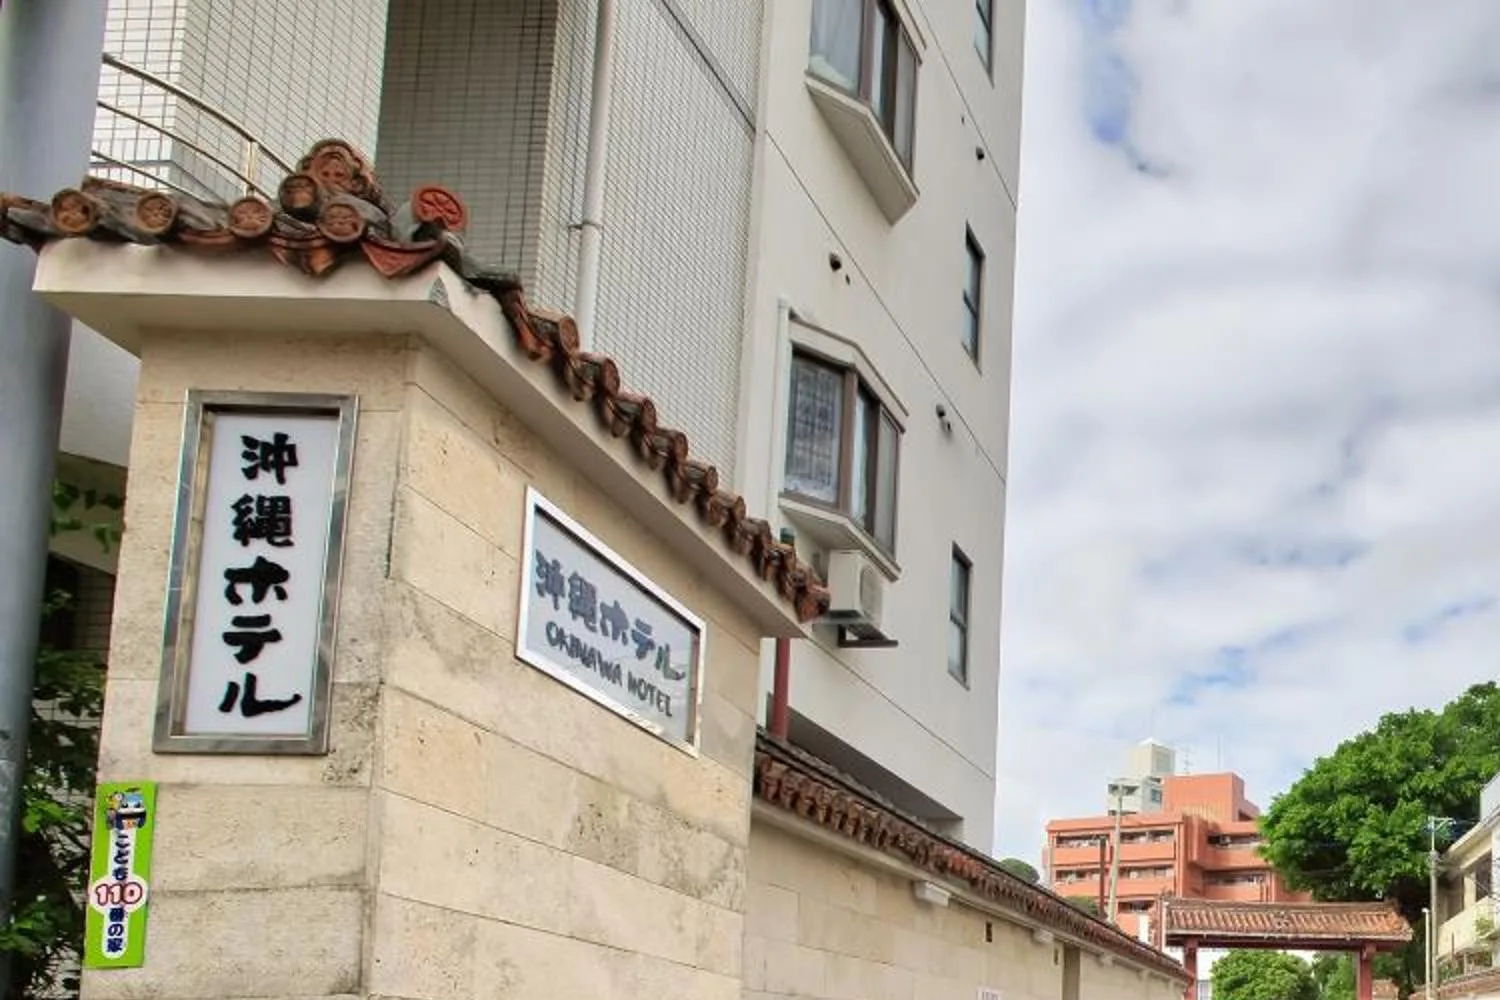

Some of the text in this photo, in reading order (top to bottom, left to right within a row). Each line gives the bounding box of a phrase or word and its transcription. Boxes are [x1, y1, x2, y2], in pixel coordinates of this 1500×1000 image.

[218, 432, 302, 718] 沖縄ホテル
[535, 548, 687, 681] 沖縄ホテル
[545, 620, 673, 718] OKINAWA HOTEL
